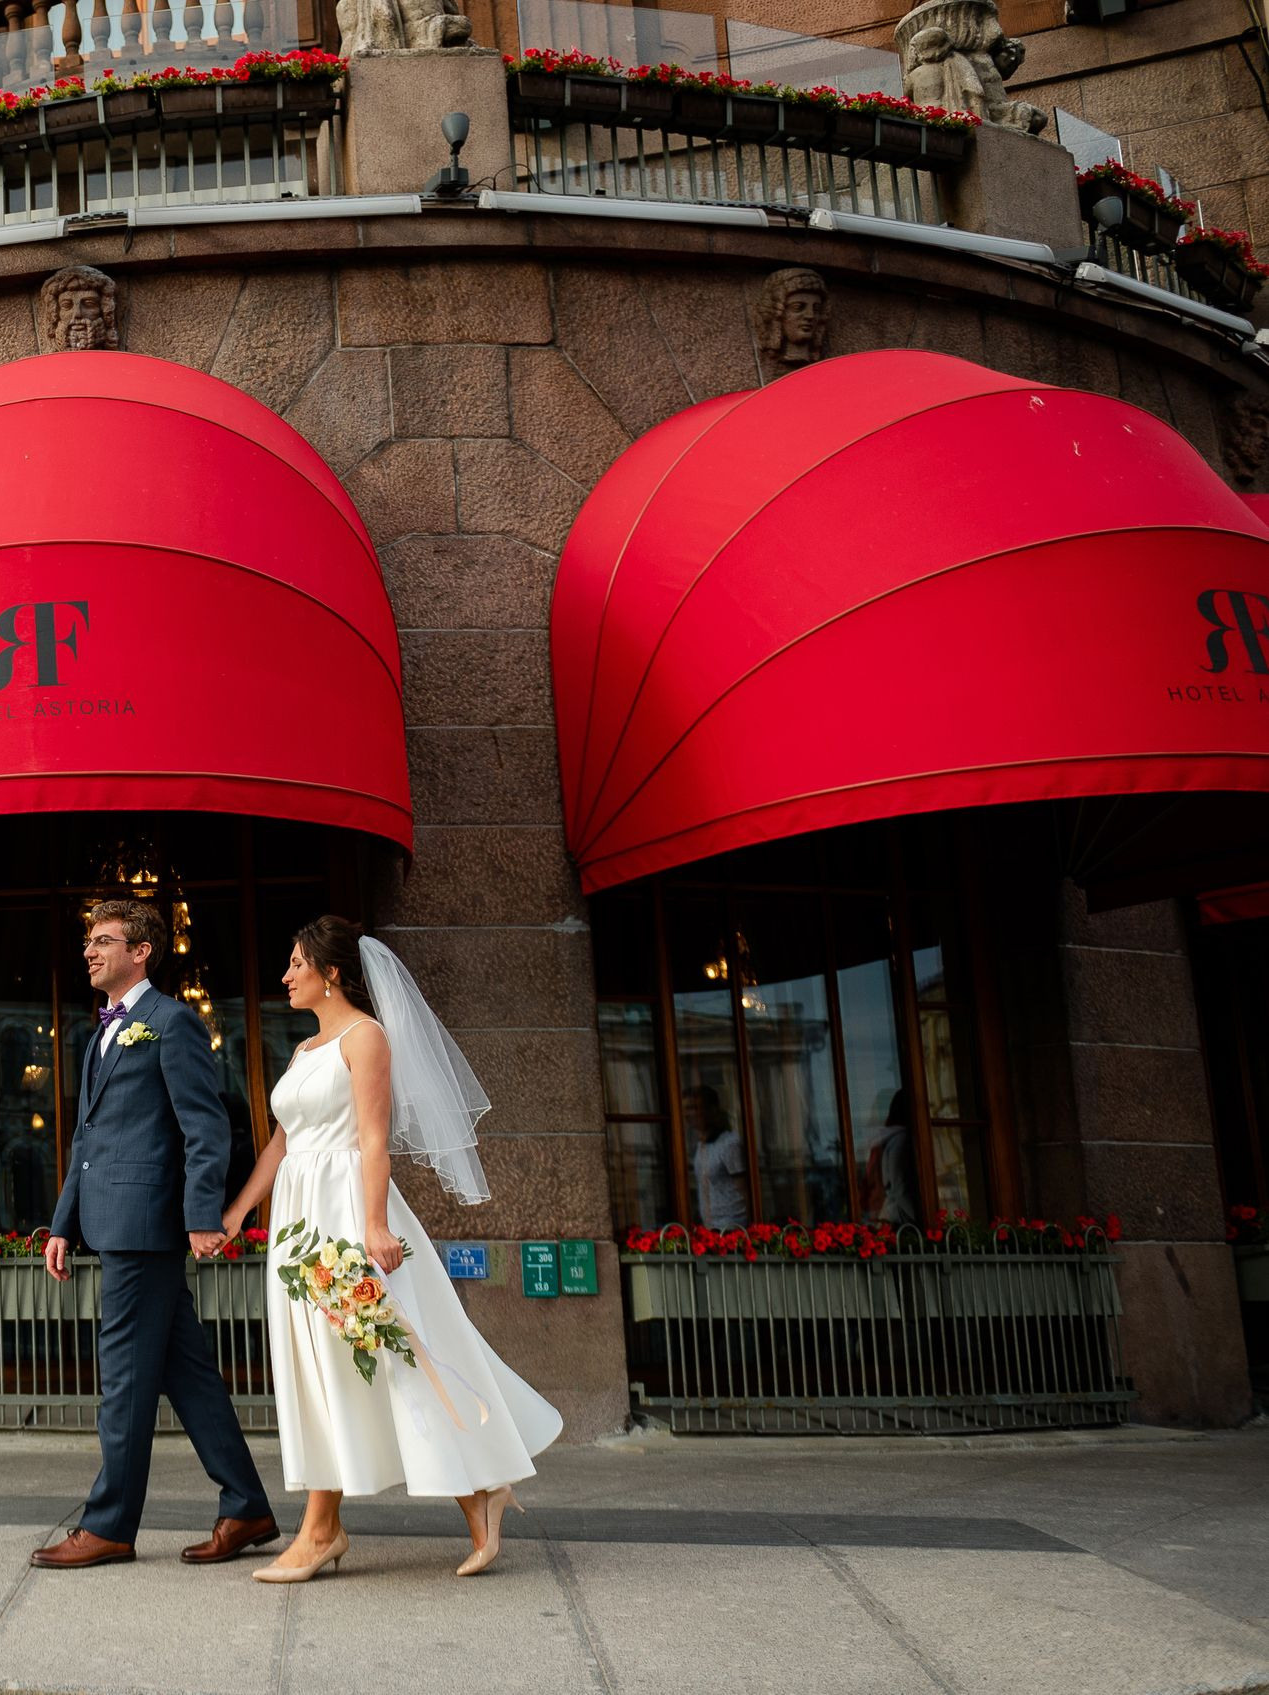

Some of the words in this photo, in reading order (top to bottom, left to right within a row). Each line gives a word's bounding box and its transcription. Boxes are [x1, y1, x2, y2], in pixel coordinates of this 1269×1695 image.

[1167, 685, 1245, 702] HOTEL
[33, 699, 136, 718] ASTORIA
[538, 1253, 553, 1263] 300
